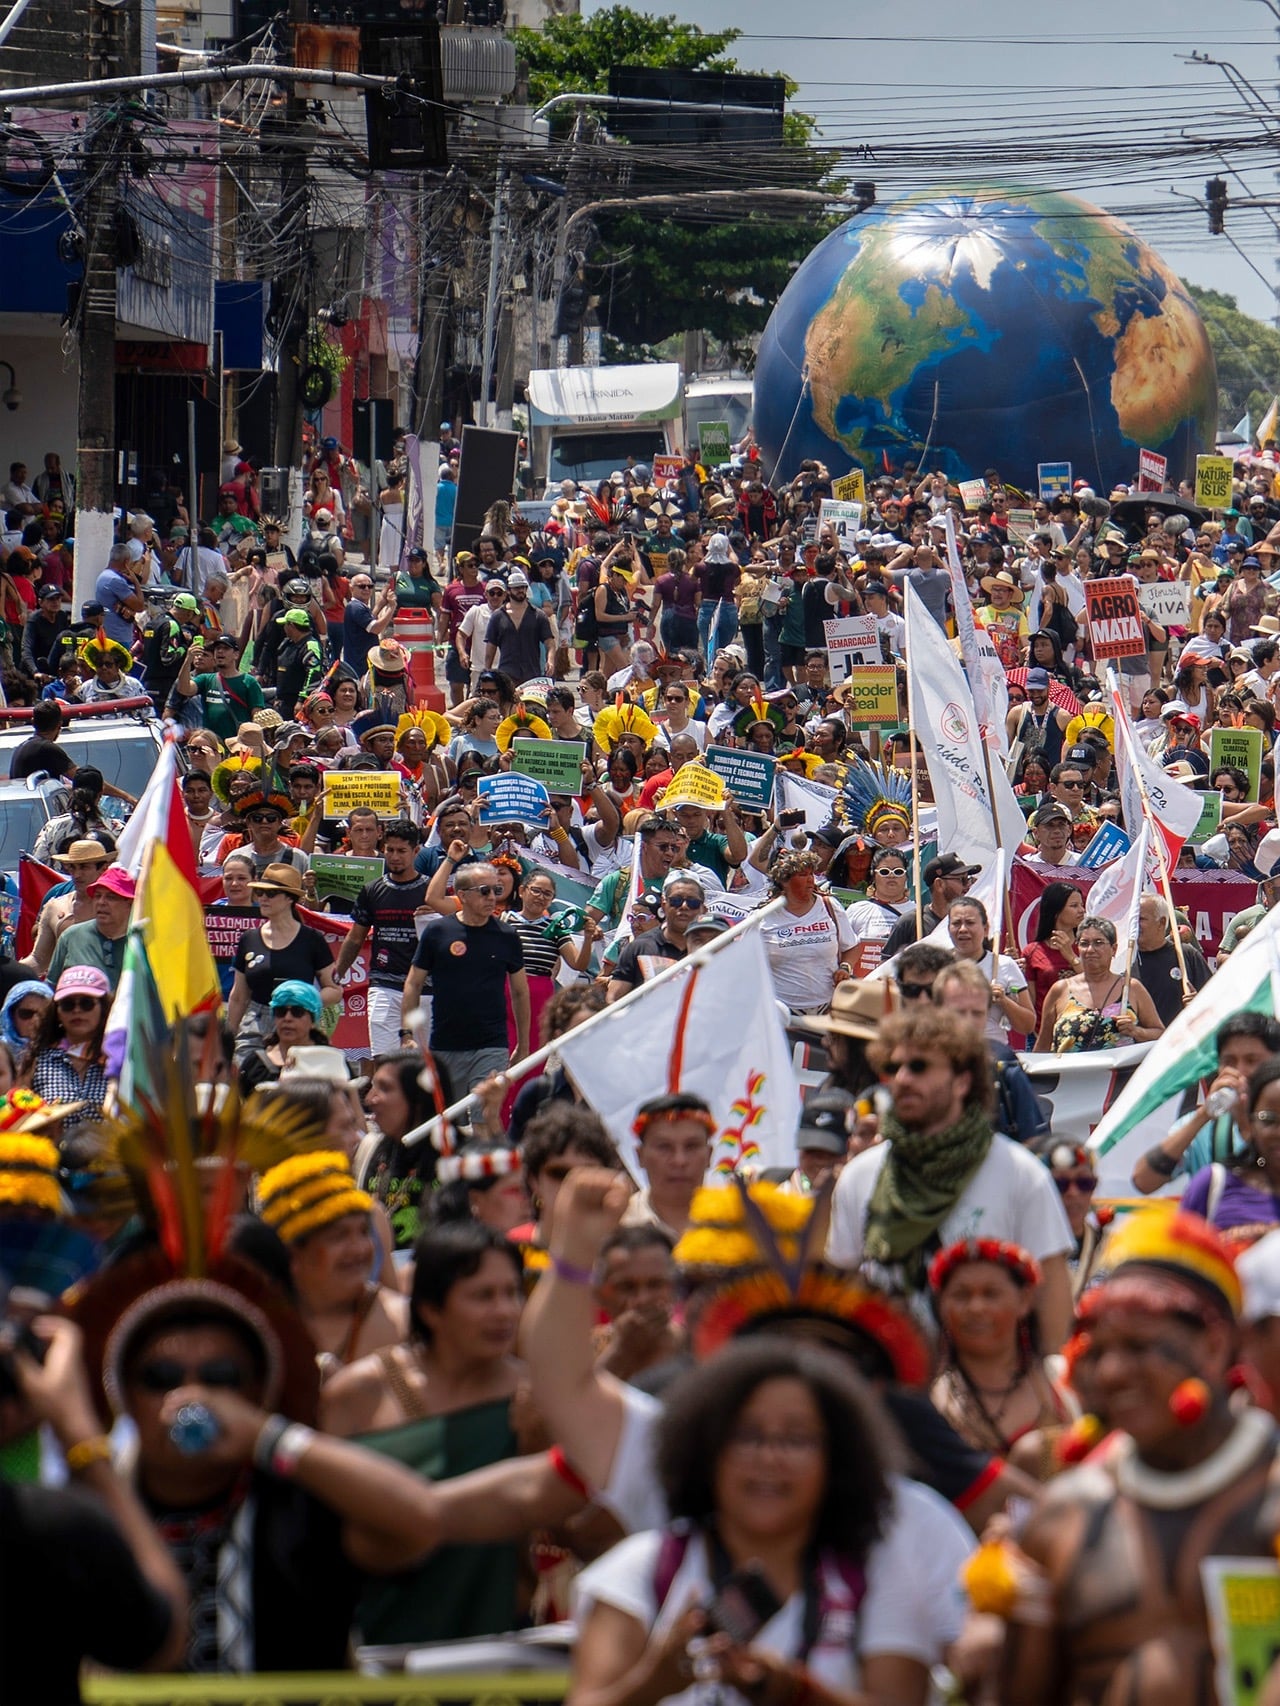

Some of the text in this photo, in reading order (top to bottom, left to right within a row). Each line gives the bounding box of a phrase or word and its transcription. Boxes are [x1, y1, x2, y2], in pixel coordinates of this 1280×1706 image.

[577, 412, 635, 423] Hakuna Matata
[1197, 469, 1233, 481] NATURE
[838, 478, 860, 495] PHASE
[1201, 484, 1227, 497] IS US
[1090, 594, 1136, 620] AGRO
[1091, 616, 1142, 644] MATA
[828, 634, 877, 649] DEMARCAÇÃO
[853, 683, 894, 697] poder
[855, 697, 879, 710] real
[1220, 754, 1249, 768] NÃO HÁ
[342, 774, 382, 783] SEM TERRITÓRIO
[333, 789, 343, 799] NÃO
[374, 790, 384, 799] NÃO
[793, 921, 830, 934] FNEEI
